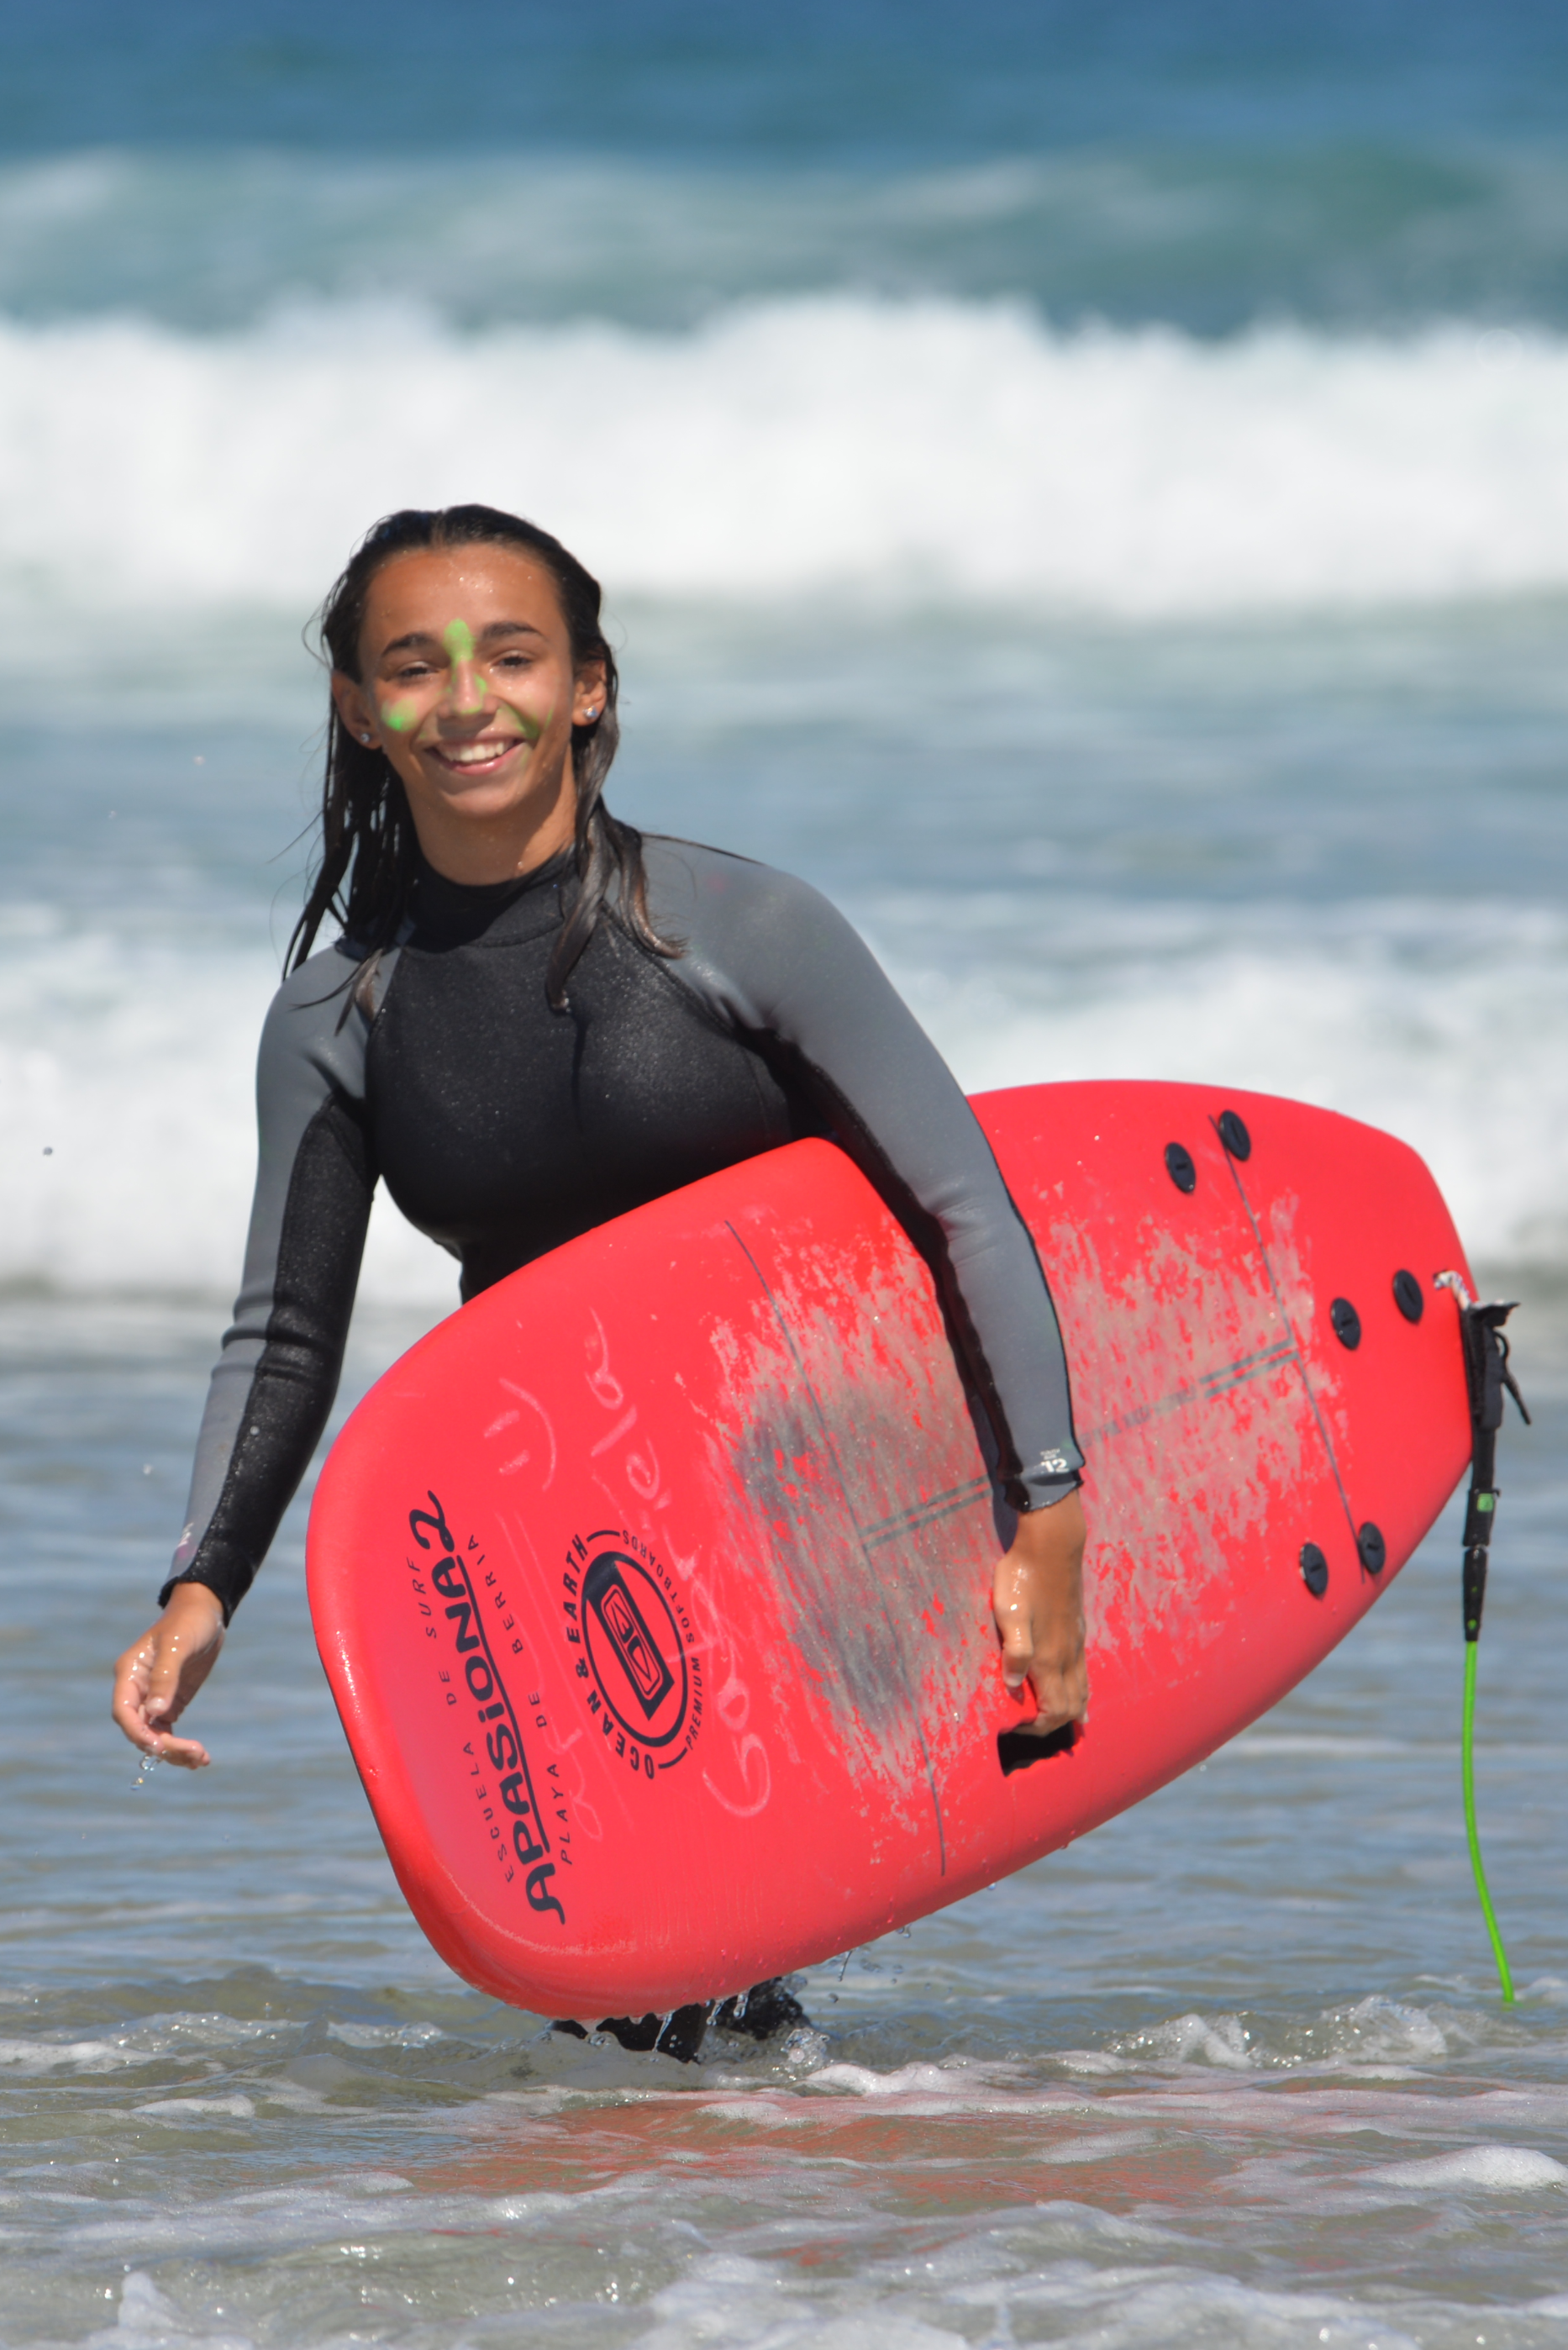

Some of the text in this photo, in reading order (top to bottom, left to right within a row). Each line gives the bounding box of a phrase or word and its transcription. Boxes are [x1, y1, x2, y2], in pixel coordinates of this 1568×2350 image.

[1039, 1457, 1070, 1473] 12
[407, 1557, 514, 1883] ESCUELA DE SURF
[467, 1535, 571, 1865] PLAYA DE BERRIA
[563, 1534, 655, 1779] OCEAN & EARTH
[623, 1530, 702, 1750] PREMIUM SOFTBOARDS
